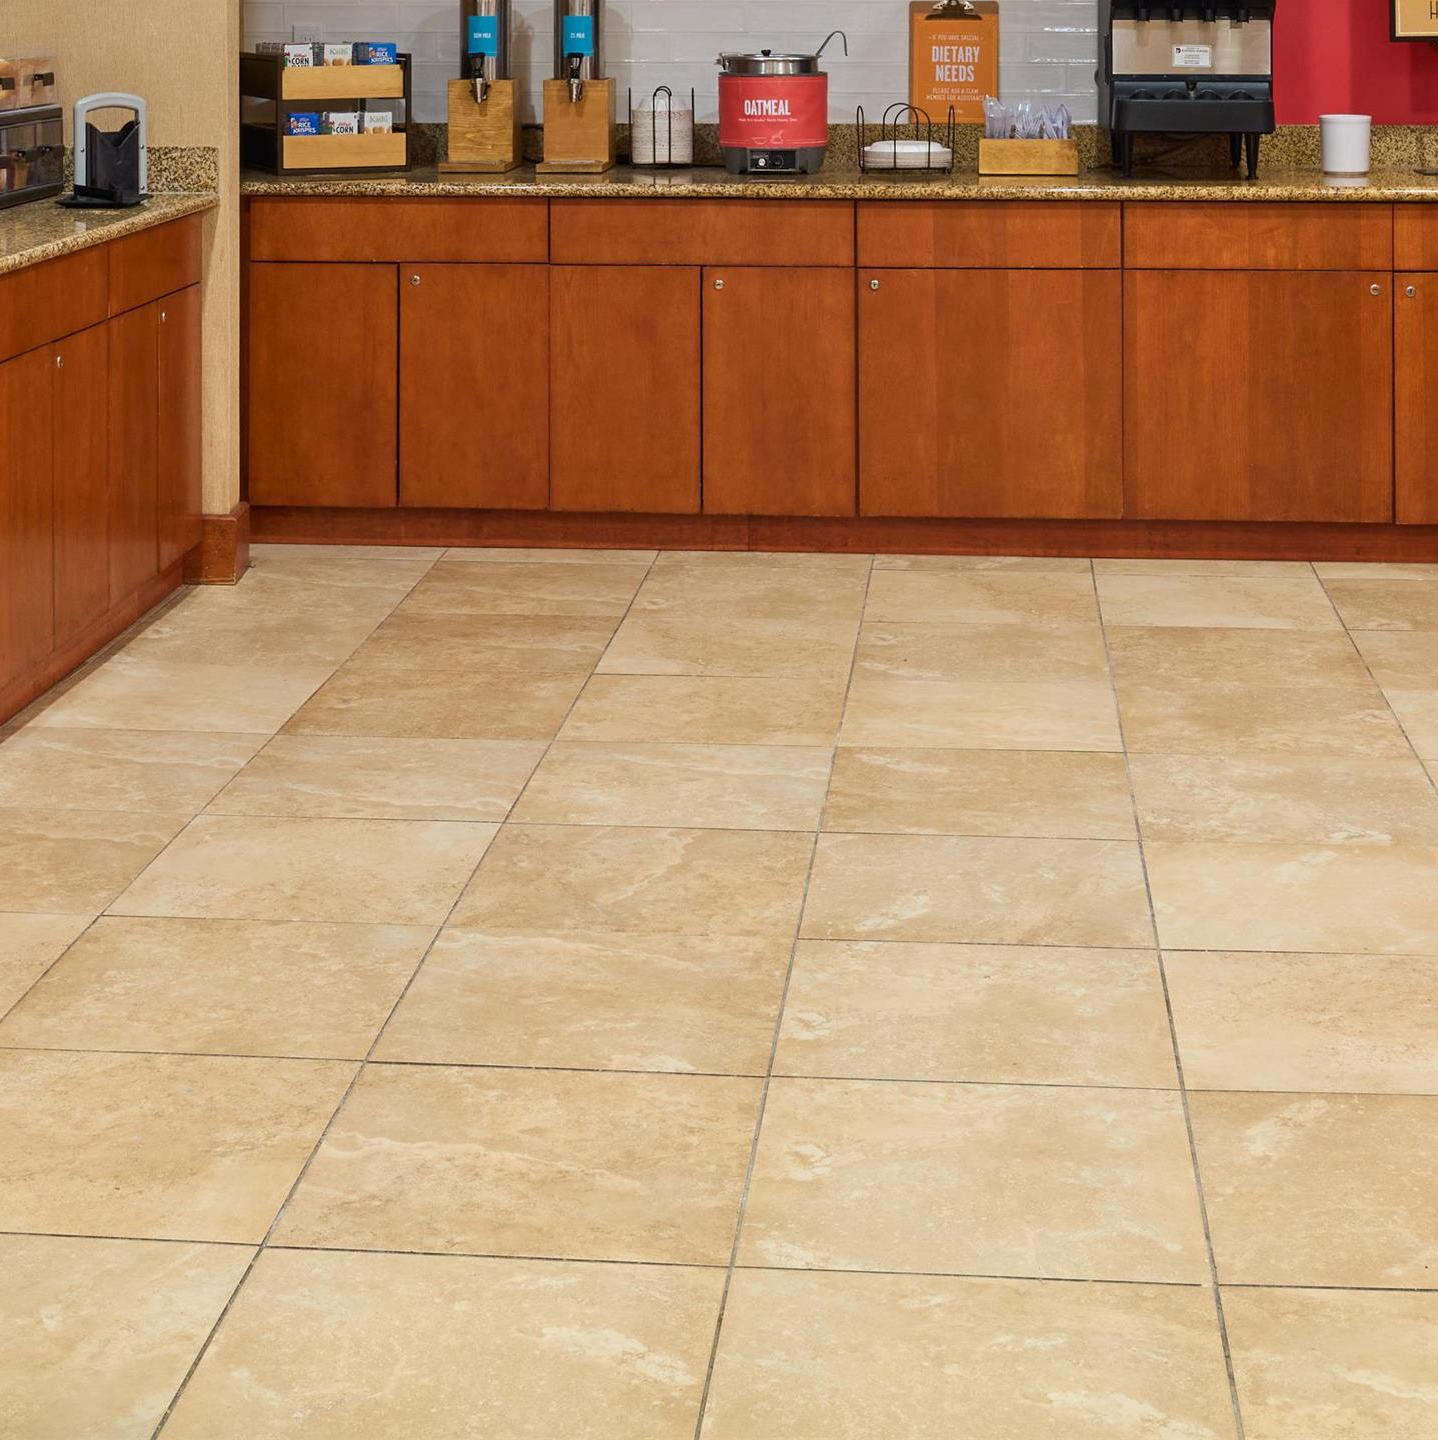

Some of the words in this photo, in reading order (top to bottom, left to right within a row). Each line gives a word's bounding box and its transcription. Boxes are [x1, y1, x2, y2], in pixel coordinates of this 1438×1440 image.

[932, 46, 980, 62] DIETARY
[936, 65, 975, 82] NEEDS
[744, 99, 791, 116] OATMEAL
